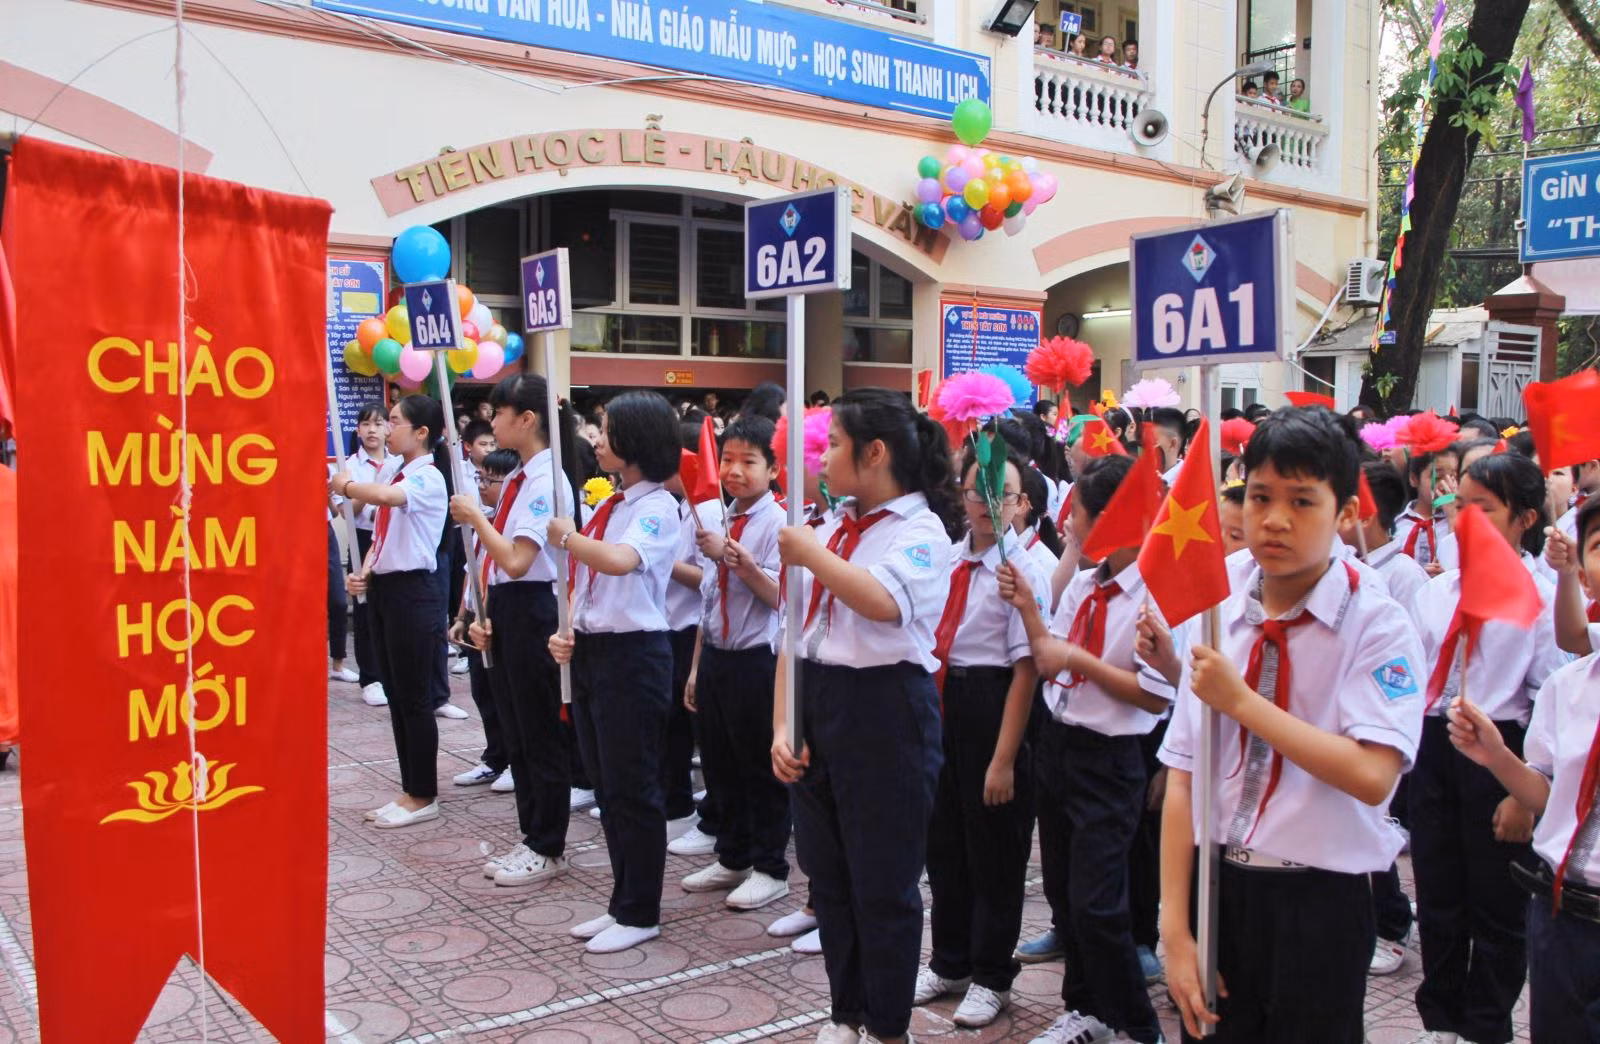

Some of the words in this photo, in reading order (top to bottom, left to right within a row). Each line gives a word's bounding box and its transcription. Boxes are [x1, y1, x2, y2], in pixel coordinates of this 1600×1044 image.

[611, 0, 654, 43] NHÀ
[659, 6, 704, 52] GIÁO
[710, 9, 751, 61] MẪU
[757, 28, 797, 76] MỰC
[813, 40, 847, 86] HỌC
[851, 49, 890, 90] SINH
[893, 58, 943, 101] THANH
[396, 145, 506, 203] TIÊN
[511, 131, 606, 177] HỌC
[620, 113, 667, 165] LỄ
[704, 136, 785, 185] HẬU
[1540, 170, 1588, 201] GÌN
[756, 236, 827, 288] 6A2
[415, 313, 452, 345] 6A4
[528, 288, 557, 326] 6A3
[1152, 282, 1254, 354] 6A1
[87, 327, 275, 401] CHÀO
[86, 414, 278, 487] MỪNG
[113, 505, 257, 574] NĂM
[116, 595, 256, 664] HỌC
[128, 662, 247, 742] MỚI
